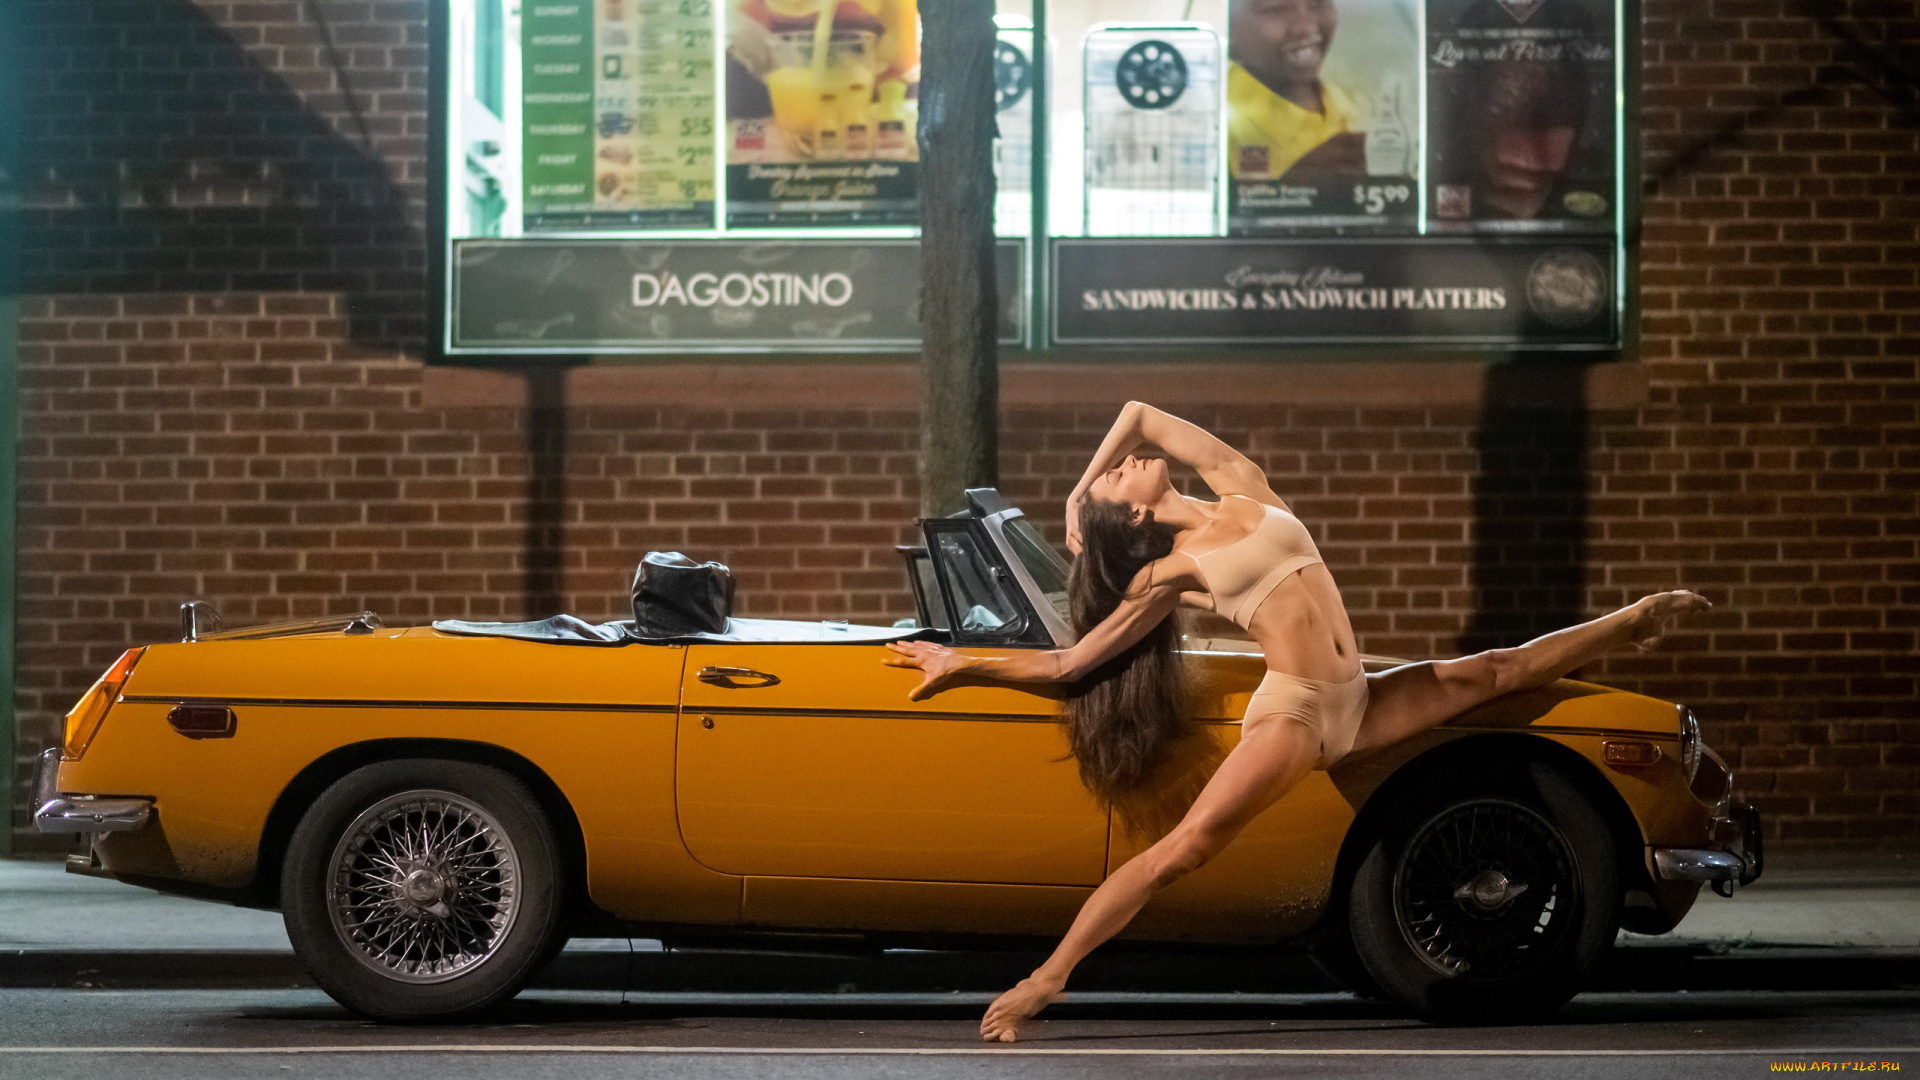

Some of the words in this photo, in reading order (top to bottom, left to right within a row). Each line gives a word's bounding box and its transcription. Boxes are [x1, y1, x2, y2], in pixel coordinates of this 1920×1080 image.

[632, 271, 853, 307] D'AGOSTINO
[1083, 289, 1237, 310] SANDWICHES
[1242, 293, 1256, 310] &
[1262, 289, 1387, 310] SANDWICH
[1393, 288, 1507, 310] PLATTERS
